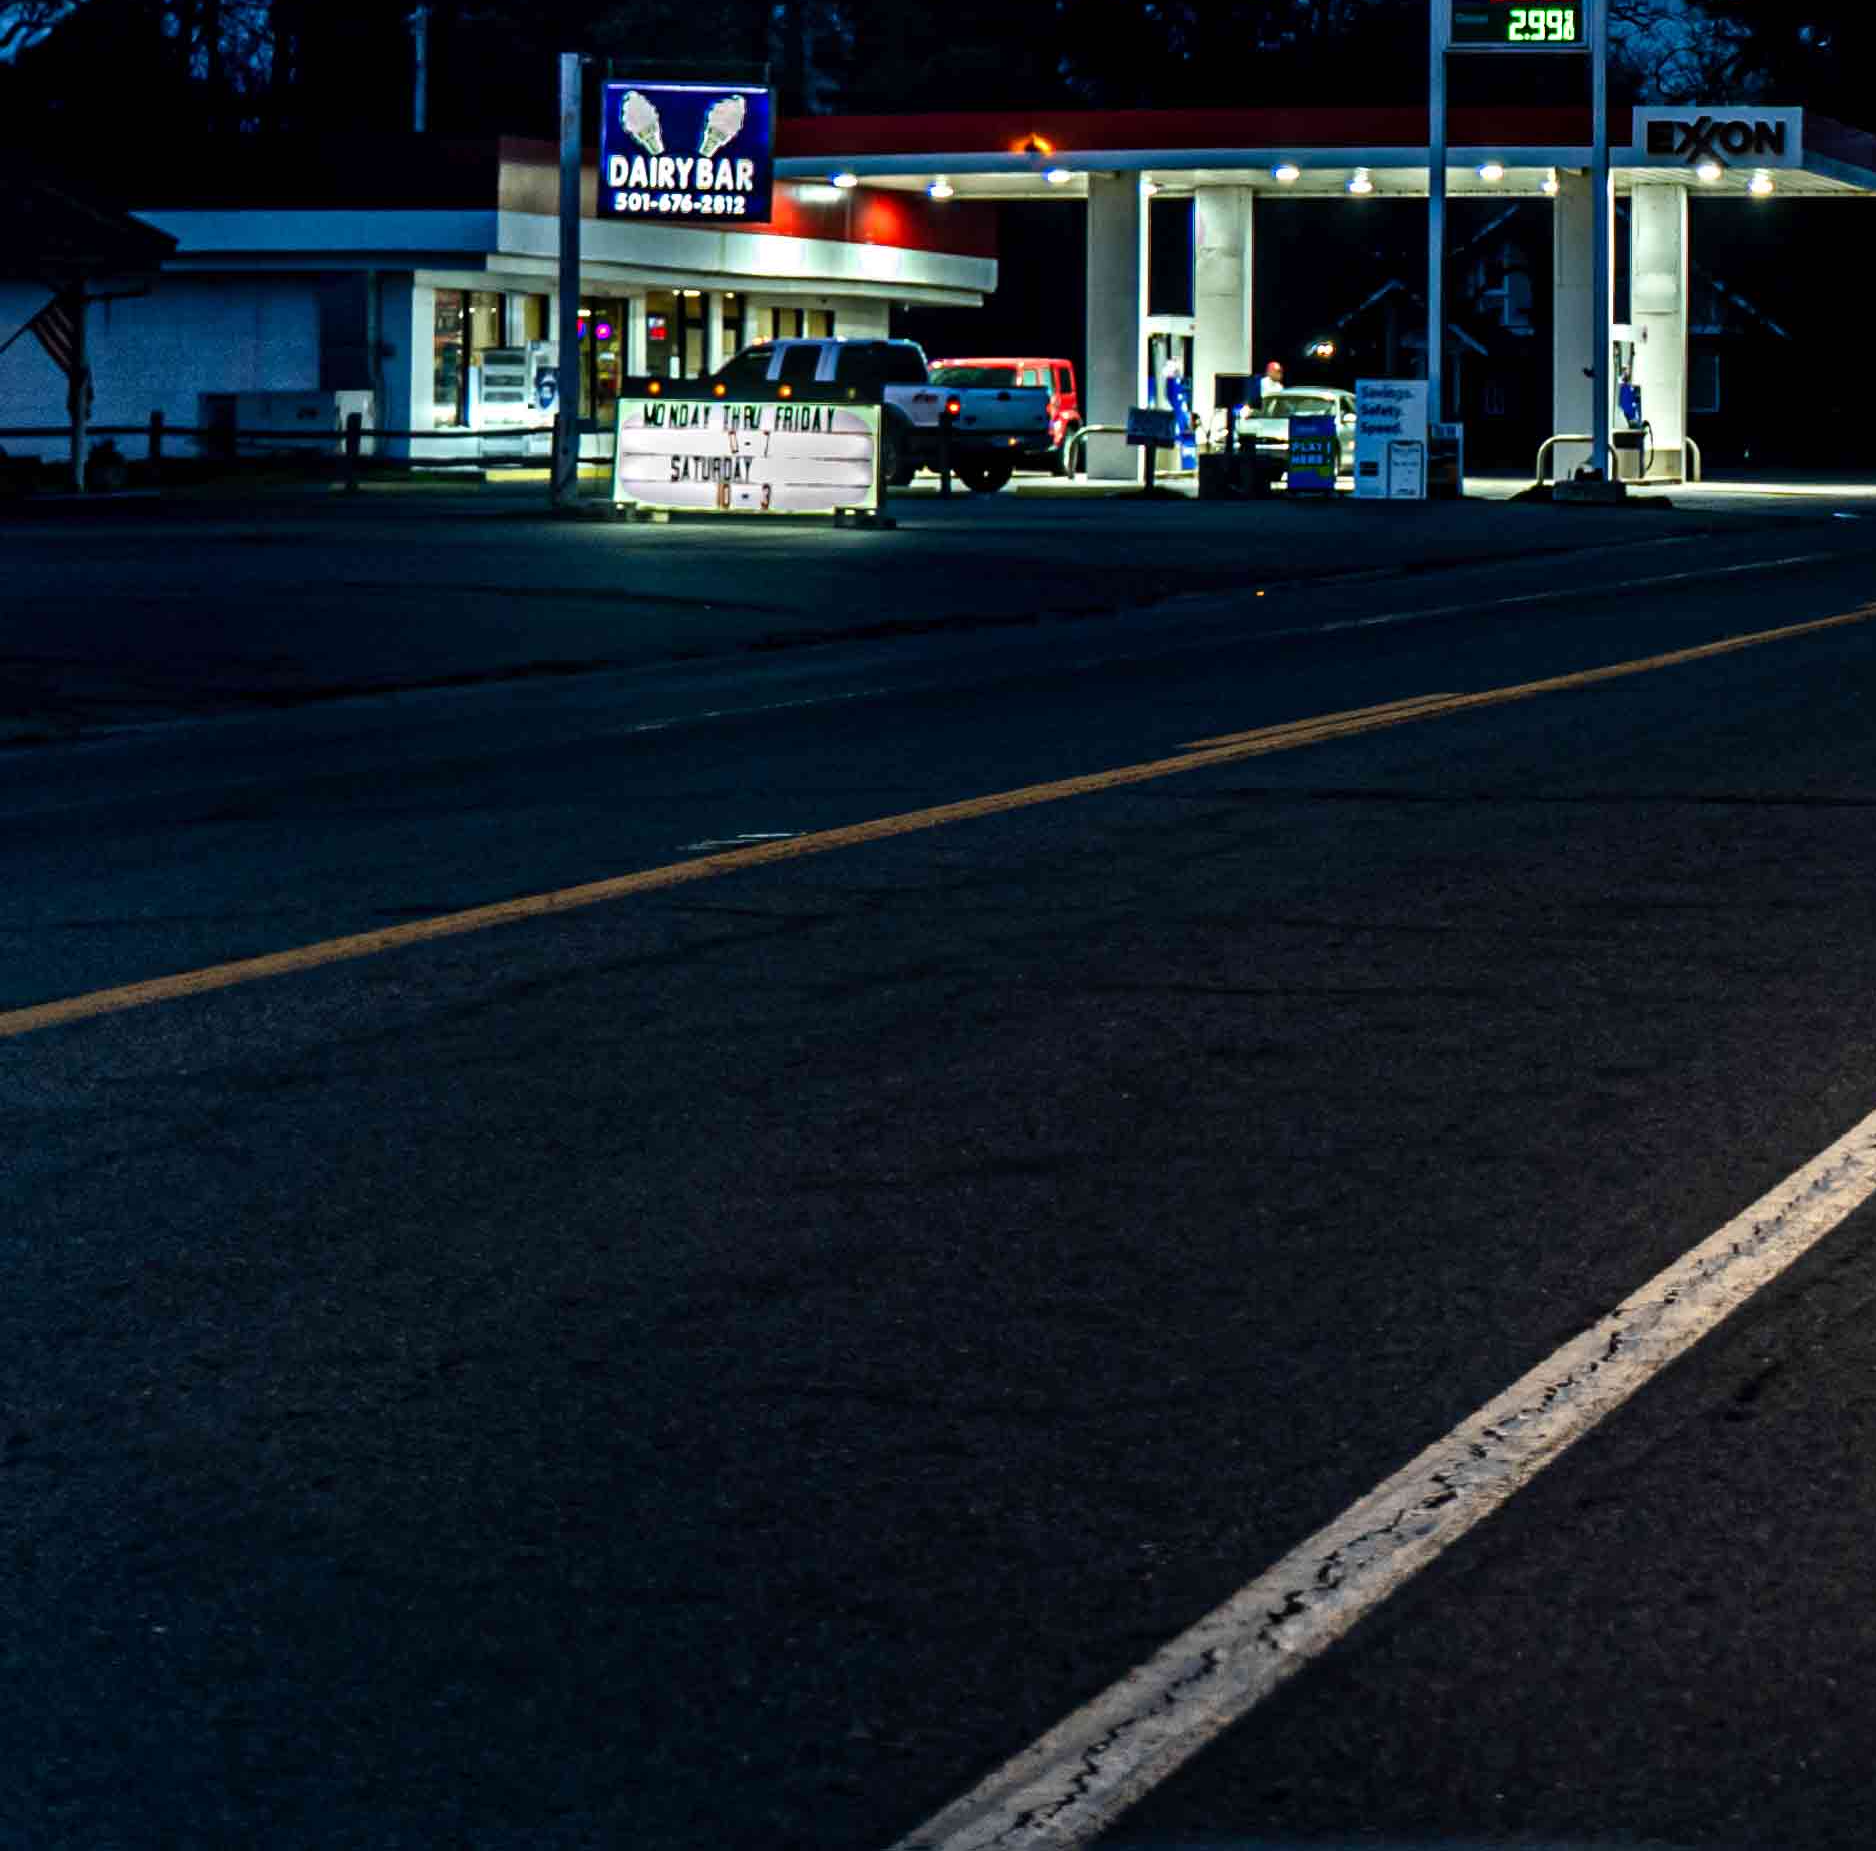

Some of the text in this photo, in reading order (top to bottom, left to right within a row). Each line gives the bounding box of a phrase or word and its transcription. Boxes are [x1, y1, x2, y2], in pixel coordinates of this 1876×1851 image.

[1508, 9, 1562, 41] 2.99
[1647, 115, 1786, 168] EXXON
[608, 154, 753, 191] DAIRY BAR
[614, 191, 746, 215] 501-676-2812
[643, 402, 835, 433] MONDAY THRU FRIDAY
[670, 455, 753, 484] SATURDAY
